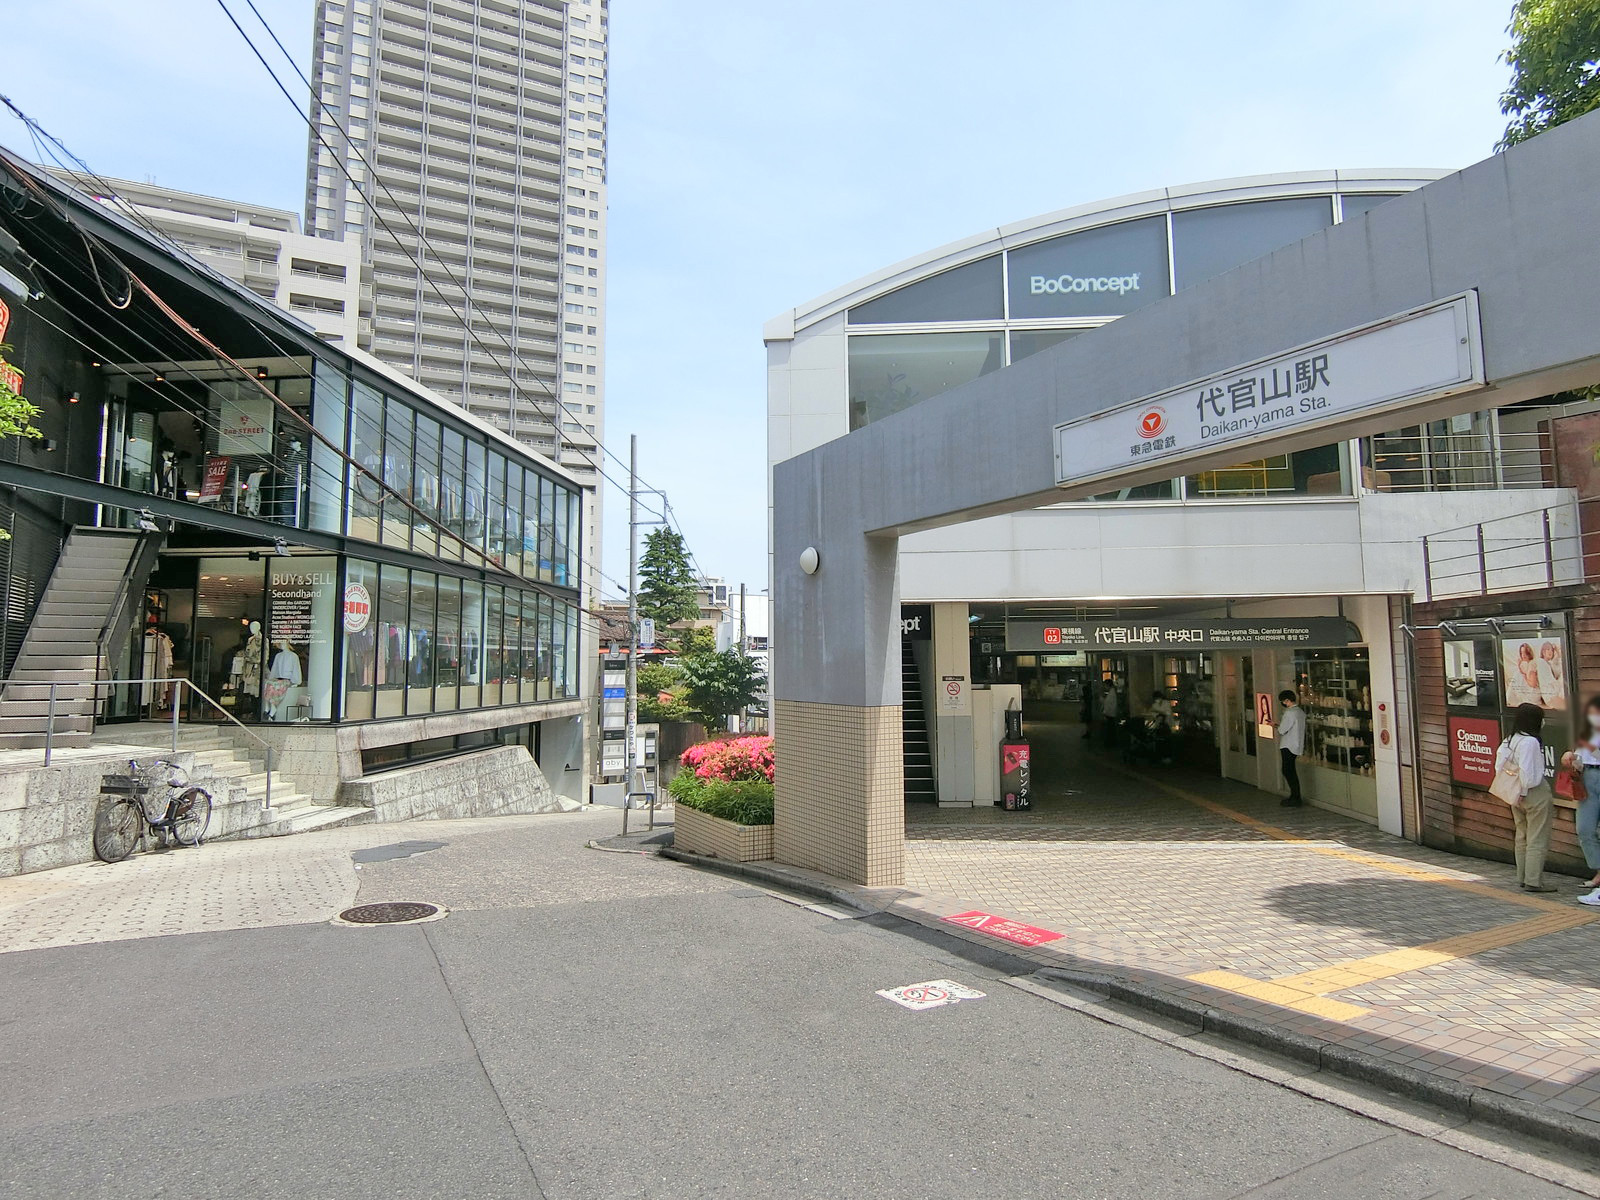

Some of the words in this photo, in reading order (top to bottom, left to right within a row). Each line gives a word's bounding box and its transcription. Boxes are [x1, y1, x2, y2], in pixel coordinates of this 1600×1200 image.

[1030, 273, 1139, 295] BoConcept
[1196, 353, 1330, 422] 代官山駅
[1200, 405, 1295, 440] Daikan-yama
[1299, 396, 1331, 413] Sta.
[1130, 435, 1176, 457] 東急電鉄
[208, 466, 227, 477] SALE
[271, 589, 322, 598] Secondhand
[1094, 626, 1160, 644] 代官山駅
[1164, 629, 1203, 643] 中央口
[1457, 729, 1487, 743] Cosme
[1457, 740, 1492, 755] Kitchen
[1019, 749, 1029, 806] 充電レンタル
